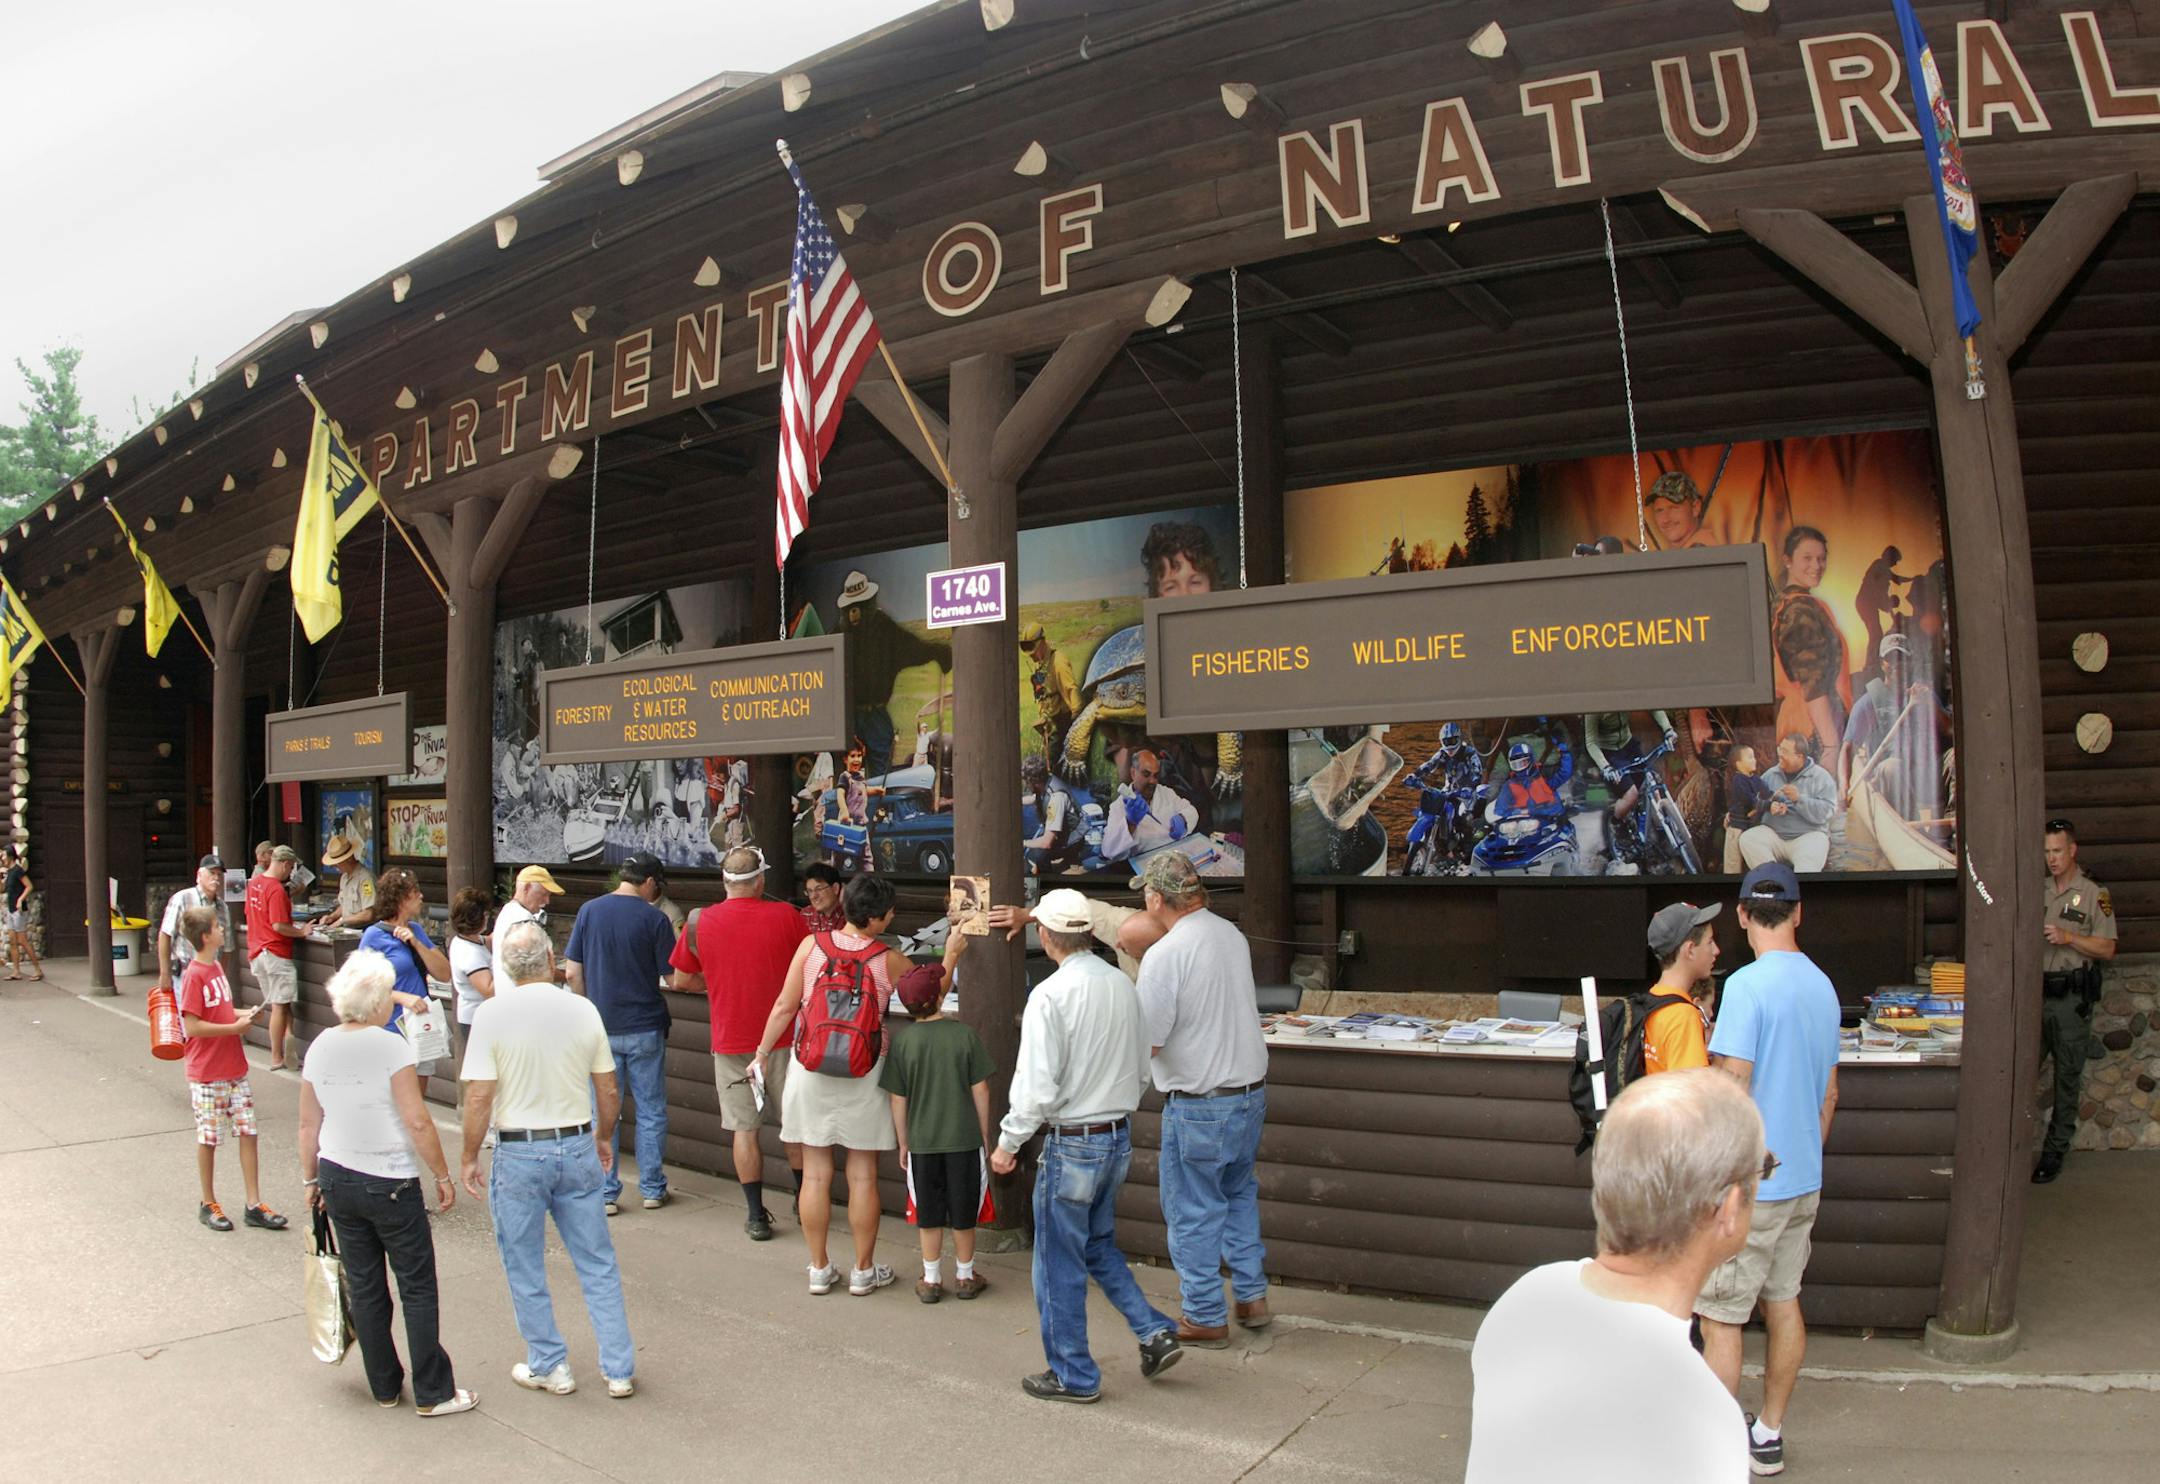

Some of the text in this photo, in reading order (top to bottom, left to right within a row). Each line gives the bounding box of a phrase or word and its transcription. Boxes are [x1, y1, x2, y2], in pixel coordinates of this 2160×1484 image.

[347, 279, 790, 502] PARTMENT
[922, 183, 1102, 317] OF
[1278, 11, 2160, 240] NATURAL
[941, 574, 991, 601] 1740
[932, 601, 1000, 619] Carnes Ave.
[1511, 616, 1711, 654] ENFORCEMENT
[1192, 646, 1310, 676] FISHERIES
[1353, 633, 1466, 665] WILDLIFE
[623, 673, 698, 698] ECOLOGICAL
[710, 671, 824, 698] COMMUNICATION
[556, 705, 613, 725] FORESTRY
[633, 698, 687, 722] & WATER
[722, 698, 811, 725] & OUTREACH
[354, 730, 382, 746] TOURISM
[624, 721, 697, 742] RESOURCES
[424, 738, 448, 755] INVA
[390, 804, 421, 825] STOP
[1976, 881, 1994, 905] Store
